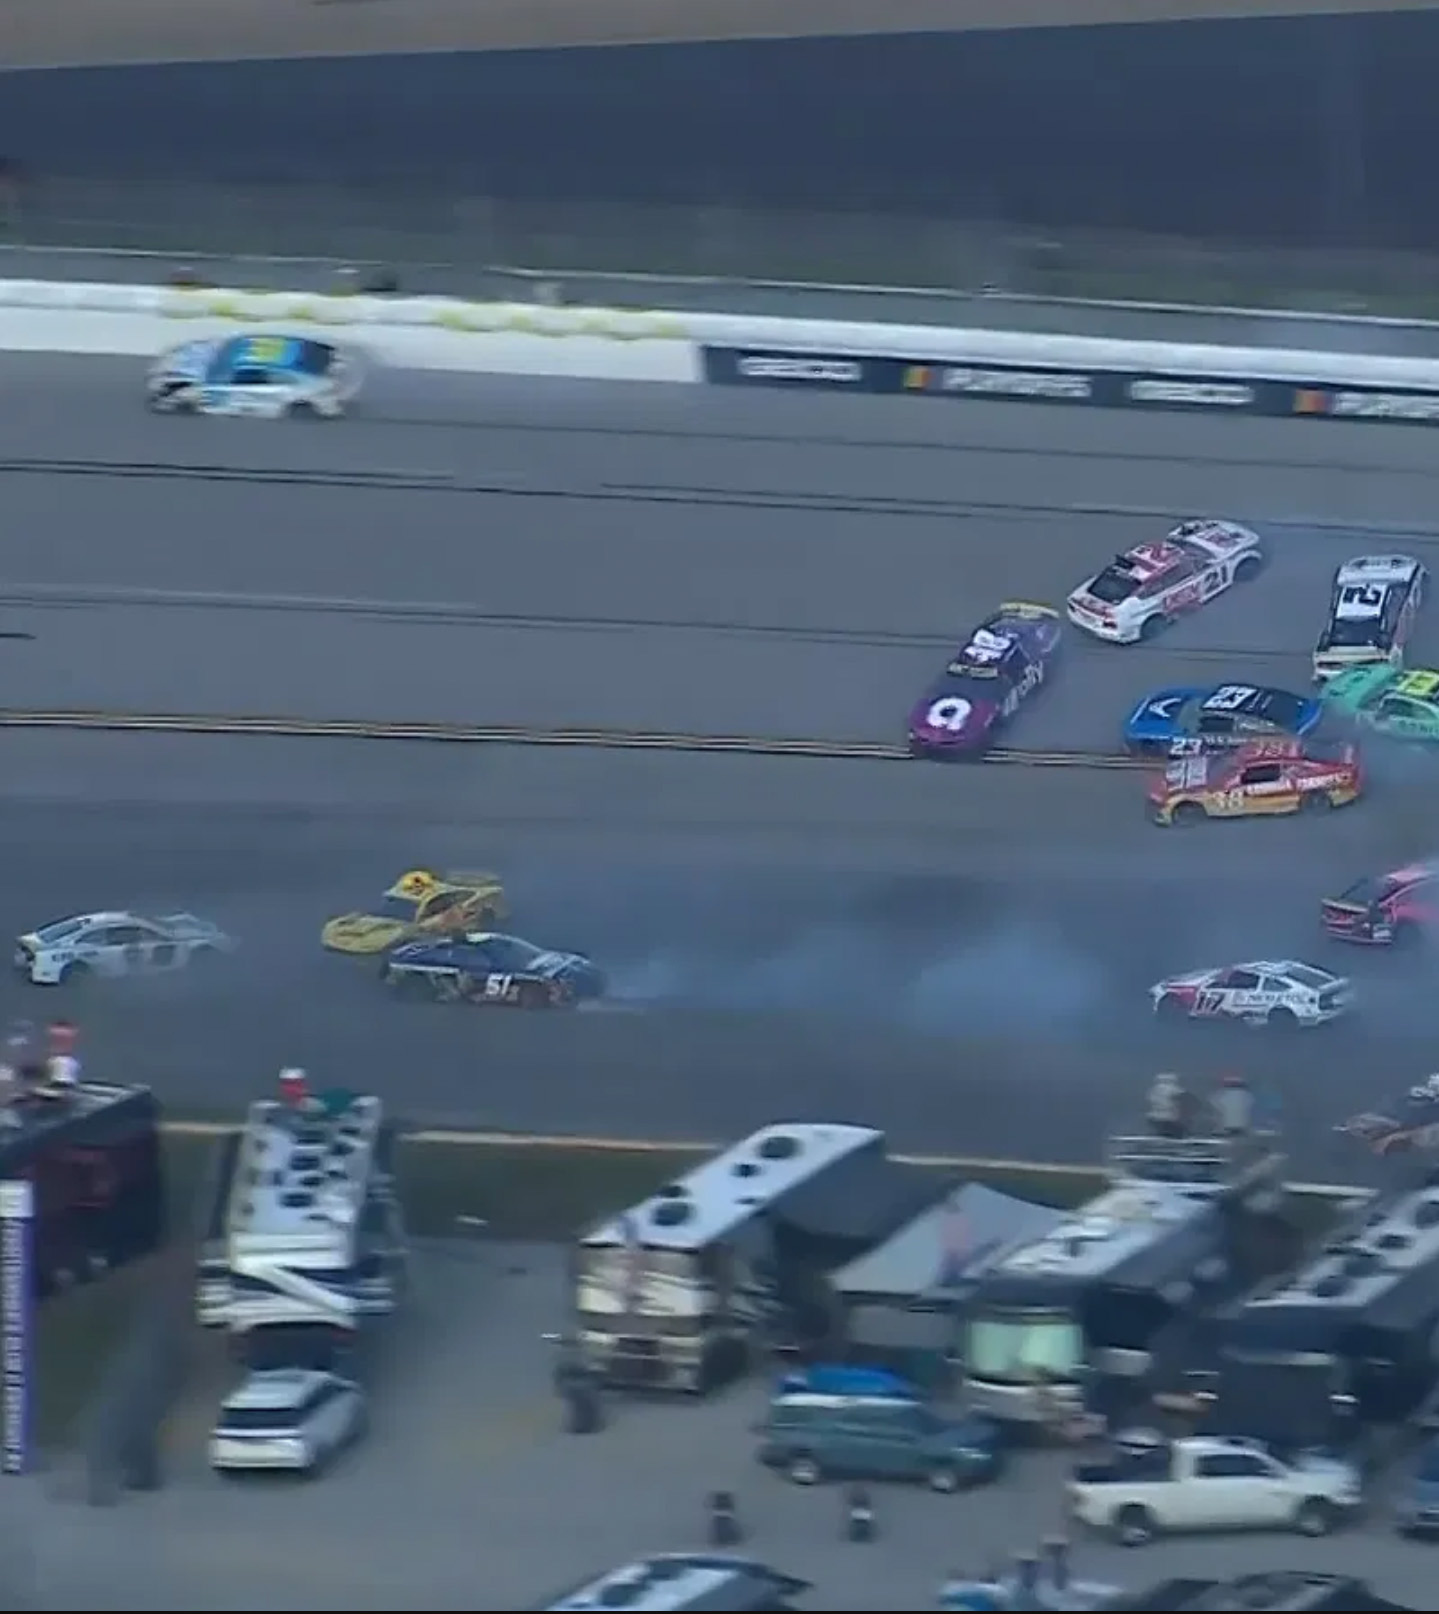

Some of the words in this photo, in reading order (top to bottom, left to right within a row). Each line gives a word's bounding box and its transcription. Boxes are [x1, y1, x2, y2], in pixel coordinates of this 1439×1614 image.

[1203, 685, 1257, 709] 23
[486, 972, 511, 996] 51
[1196, 990, 1226, 1011] 17
